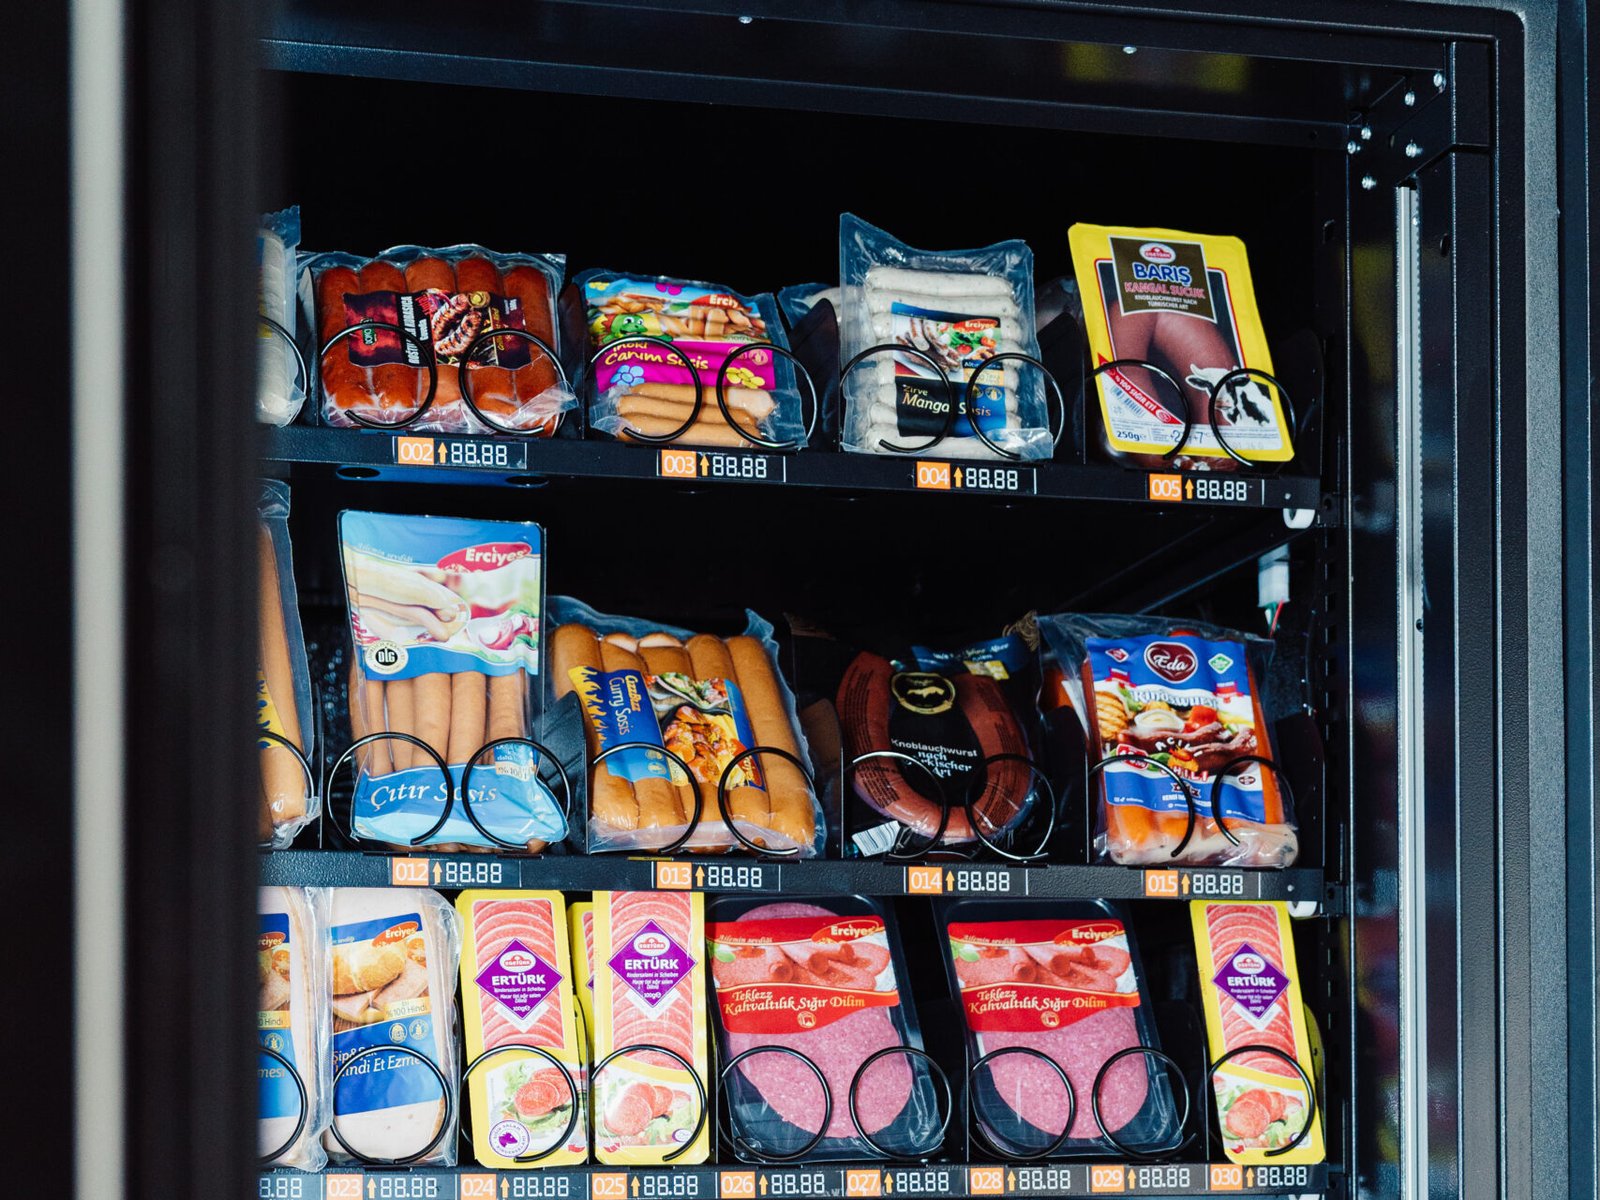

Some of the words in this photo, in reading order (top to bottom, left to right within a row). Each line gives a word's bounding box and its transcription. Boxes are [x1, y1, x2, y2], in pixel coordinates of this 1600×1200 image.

[1132, 262, 1192, 287] BARIŞ
[1124, 282, 1169, 294] KANGAL
[1170, 285, 1206, 298] SUCUK
[400, 442, 433, 461] 002
[451, 443, 507, 466] 88.88
[664, 455, 696, 474] 003
[713, 455, 766, 478] 88.88
[918, 467, 949, 485] 004
[966, 468, 1018, 490] 88.88
[1152, 479, 1181, 497] 005
[1197, 480, 1246, 501] 88.88
[465, 547, 527, 566] Erciyes
[1153, 654, 1188, 671] Eda
[608, 677, 625, 707] Curry
[1132, 689, 1219, 708] Rindswurst
[616, 708, 634, 735] Sosis
[891, 738, 978, 757] Knoblauchwurst
[918, 750, 947, 761] nach
[370, 785, 430, 812] Çıtır
[396, 862, 428, 881] 012
[446, 862, 501, 883] 88.88
[660, 867, 691, 885] 013
[708, 866, 761, 887] 88.88
[911, 872, 941, 889] 014
[958, 871, 1009, 891] 88.88
[1148, 875, 1177, 892] 015
[1193, 874, 1243, 894] 88.88
[385, 927, 417, 938] Erciyes
[624, 957, 679, 970] ERTÜRK
[491, 973, 546, 985] ERTÜRK
[1227, 975, 1276, 986] ERTÜRK
[732, 989, 773, 1001] Teklezz
[977, 988, 1017, 1000] Teklezz
[407, 1004, 427, 1012] Hindi
[723, 999, 800, 1015] Kahvaltılık
[800, 997, 827, 1012] Sığır
[830, 995, 865, 1007] Dilim
[968, 999, 1041, 1014] Kahvaltılık
[1042, 998, 1070, 1012] Sığır
[1072, 997, 1107, 1008] Dilim
[593, 1177, 625, 1195] 025
[644, 1176, 698, 1195] 88.88
[721, 1176, 754, 1193] 026
[772, 1174, 824, 1194] 88.88
[846, 1174, 881, 1192] 027
[897, 1172, 949, 1193] 88.88
[971, 1172, 1002, 1189] 028
[1019, 1168, 1070, 1190] 88.88
[1092, 1170, 1123, 1187] 029
[1139, 1165, 1190, 1188] 88.88
[1211, 1168, 1241, 1185] 030
[1257, 1167, 1306, 1186] 88.88
[327, 1178, 362, 1197] 023
[381, 1178, 437, 1198] 88.88
[461, 1178, 495, 1196] 024
[514, 1177, 568, 1197] 88.88
